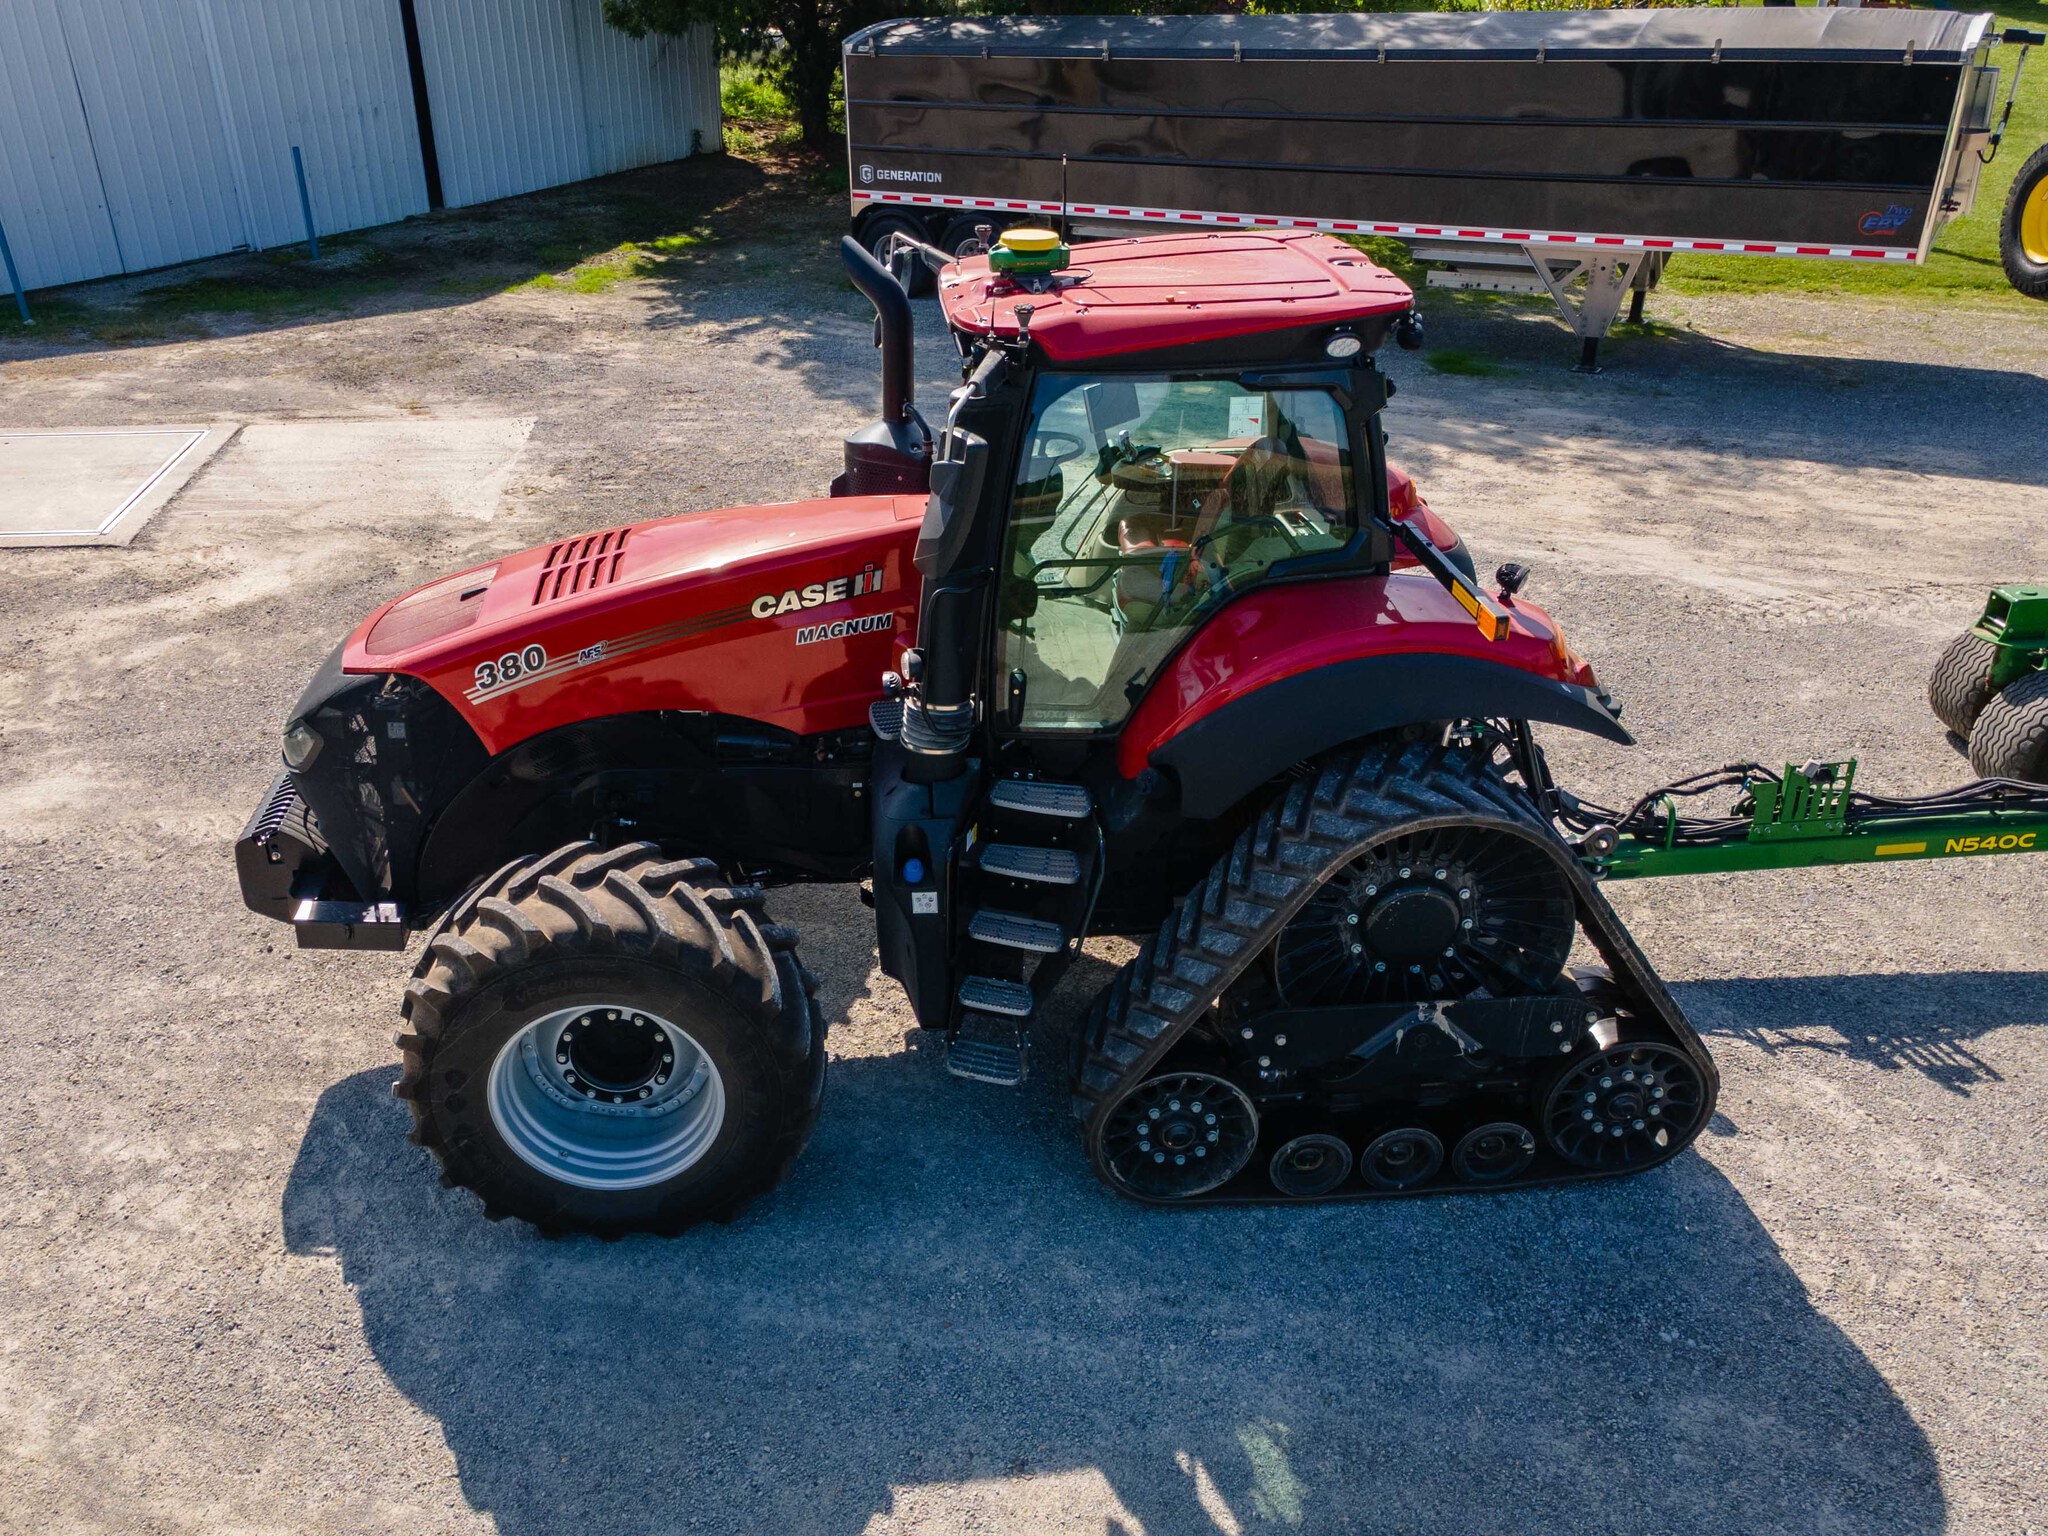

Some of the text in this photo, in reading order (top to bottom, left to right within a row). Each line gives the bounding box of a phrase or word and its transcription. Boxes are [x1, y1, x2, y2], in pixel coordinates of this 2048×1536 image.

[876, 169, 942, 183] GENERATION
[751, 576, 848, 619] CASE
[795, 612, 894, 646] MAGNUM
[474, 643, 547, 691] 380
[578, 645, 602, 662] AFS
[1944, 832, 2037, 854] N540C
